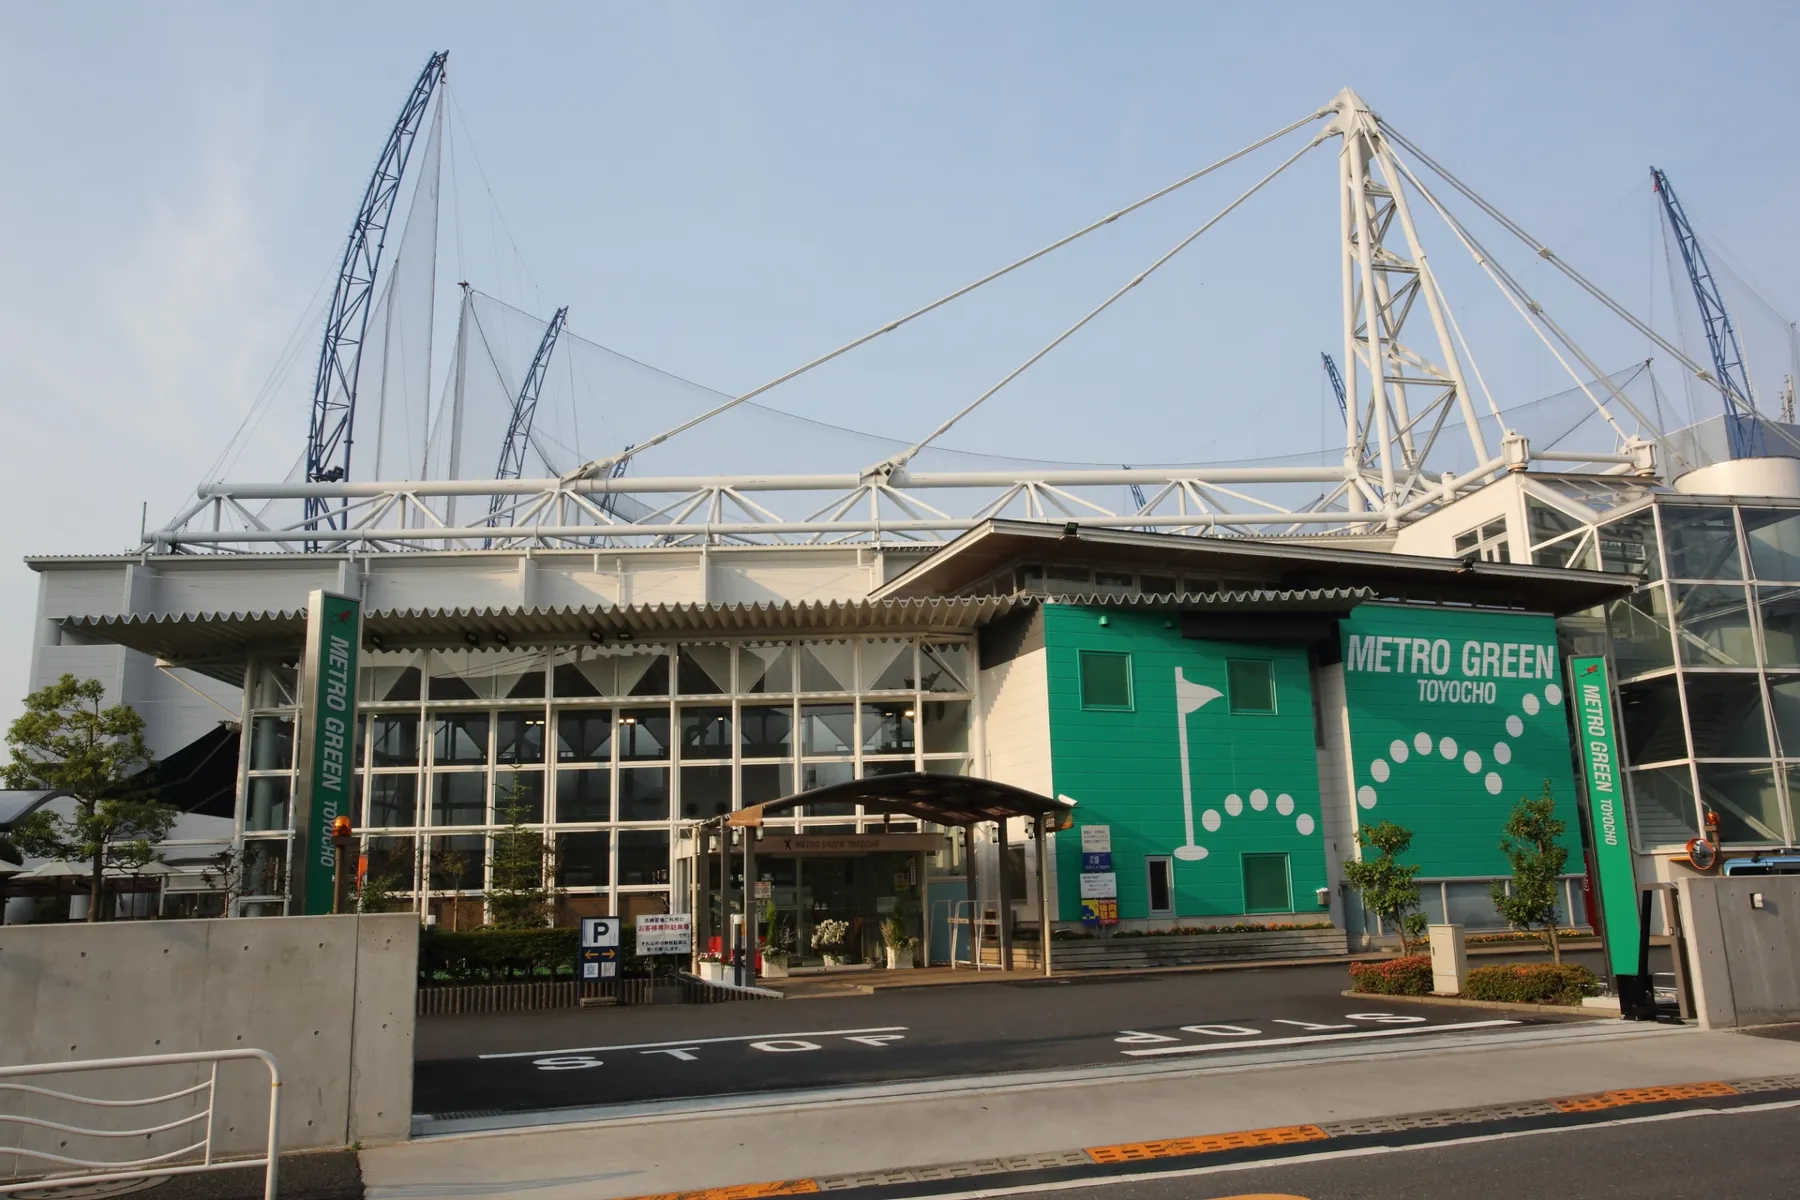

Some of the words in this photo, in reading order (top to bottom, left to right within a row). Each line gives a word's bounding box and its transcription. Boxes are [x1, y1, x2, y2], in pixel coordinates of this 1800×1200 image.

[326, 635, 349, 712] METRO
[1347, 634, 1450, 675] METRO
[1461, 640, 1554, 679] GREEN
[1417, 679, 1496, 704] TOYOCHO
[1583, 684, 1606, 737] METRO
[322, 717, 344, 791] GREEN
[1590, 741, 1612, 792] GREEN
[795, 840, 820, 848] METRO
[821, 840, 844, 848] GREEN
[1600, 799, 1617, 846] TOYOCHO
[593, 922, 609, 943] P
[1114, 1013, 1427, 1043] STOP
[532, 1034, 906, 1070] STOP
